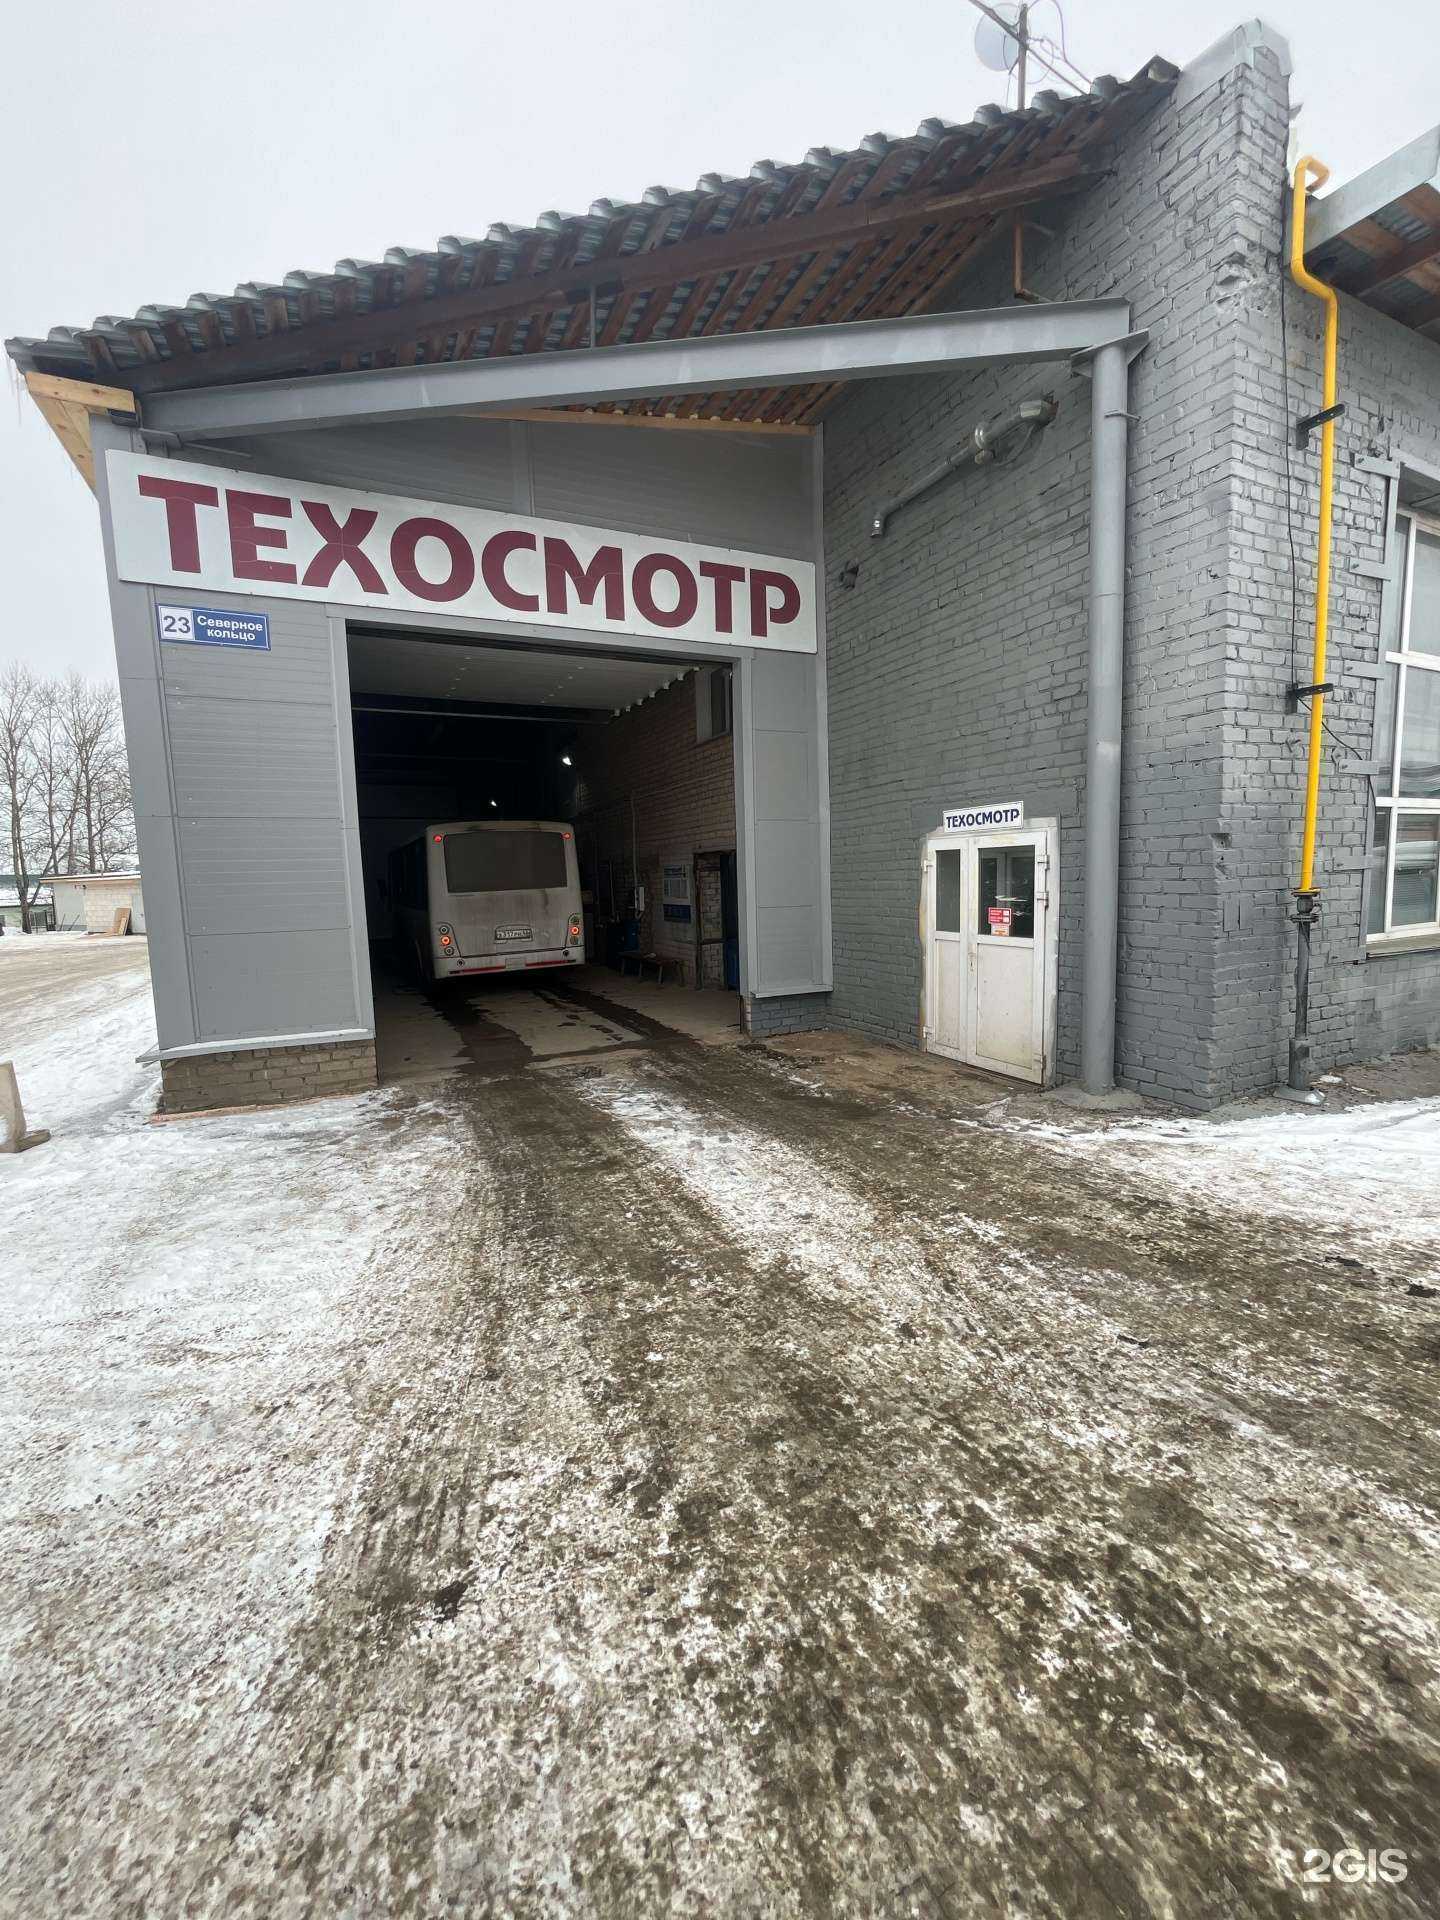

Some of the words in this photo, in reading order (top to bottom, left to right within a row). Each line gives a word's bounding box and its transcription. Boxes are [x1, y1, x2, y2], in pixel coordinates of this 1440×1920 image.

[138, 474, 801, 638] ТЕХОСМОТР
[163, 615, 191, 634] 23
[197, 615, 263, 631] Северное
[207, 628, 256, 641] кольцо
[946, 808, 1020, 828] ТЕХОСМОТР
